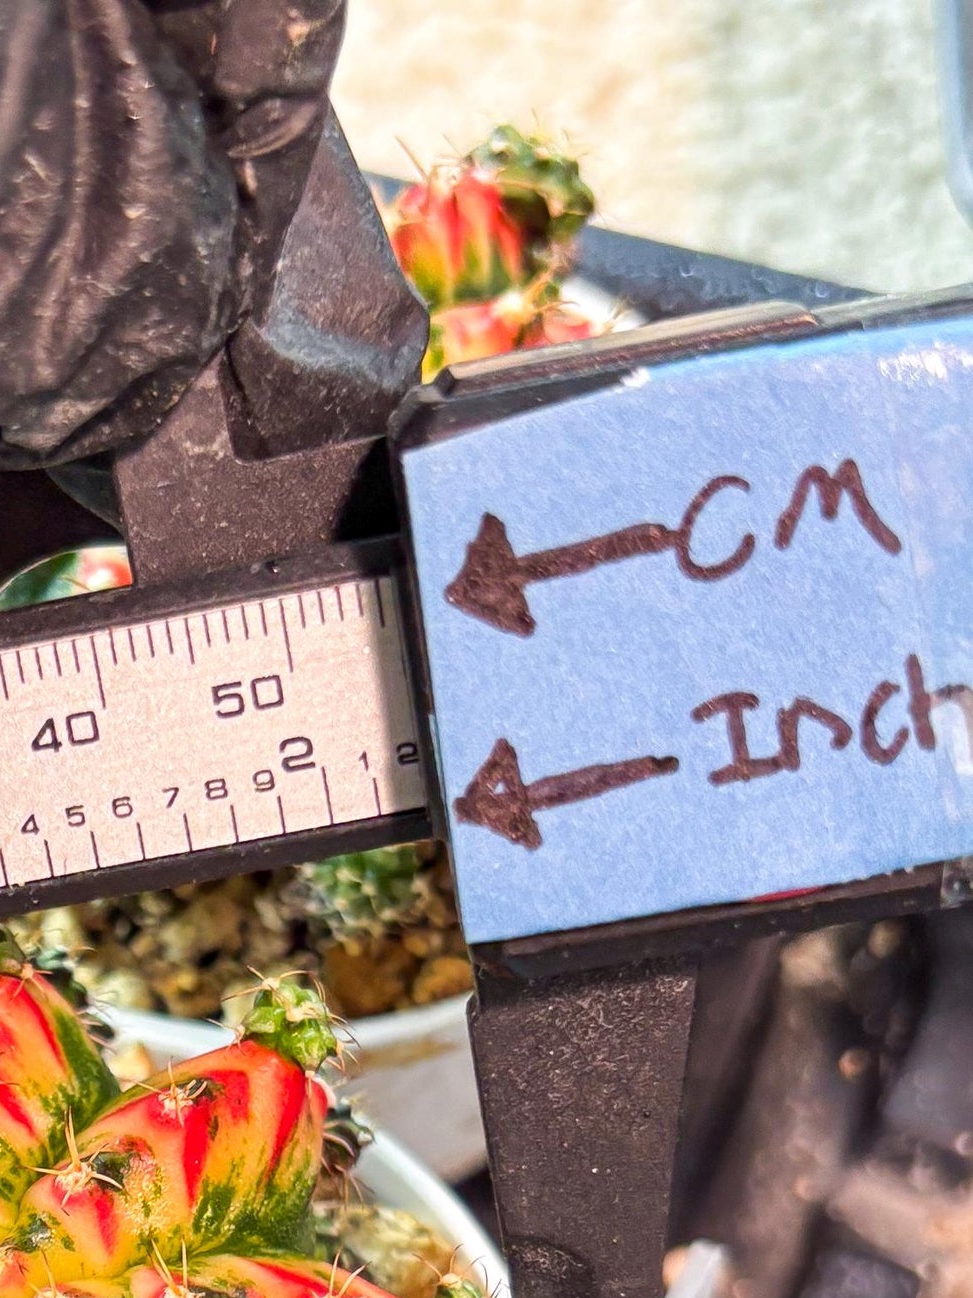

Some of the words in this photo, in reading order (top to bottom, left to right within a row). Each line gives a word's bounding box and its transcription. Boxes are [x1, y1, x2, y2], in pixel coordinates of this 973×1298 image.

[674, 458, 902, 582] CM
[31, 710, 100, 752] 40
[211, 674, 284, 719] 50
[21, 814, 39, 834] 4
[65, 805, 86, 827] 5
[111, 796, 133, 818] 6
[162, 787, 179, 808] 7
[204, 778, 228, 800] 8
[252, 769, 275, 792] 9
[279, 736, 316, 772] 2
[358, 751, 369, 772] 1
[396, 742, 419, 765] 2
